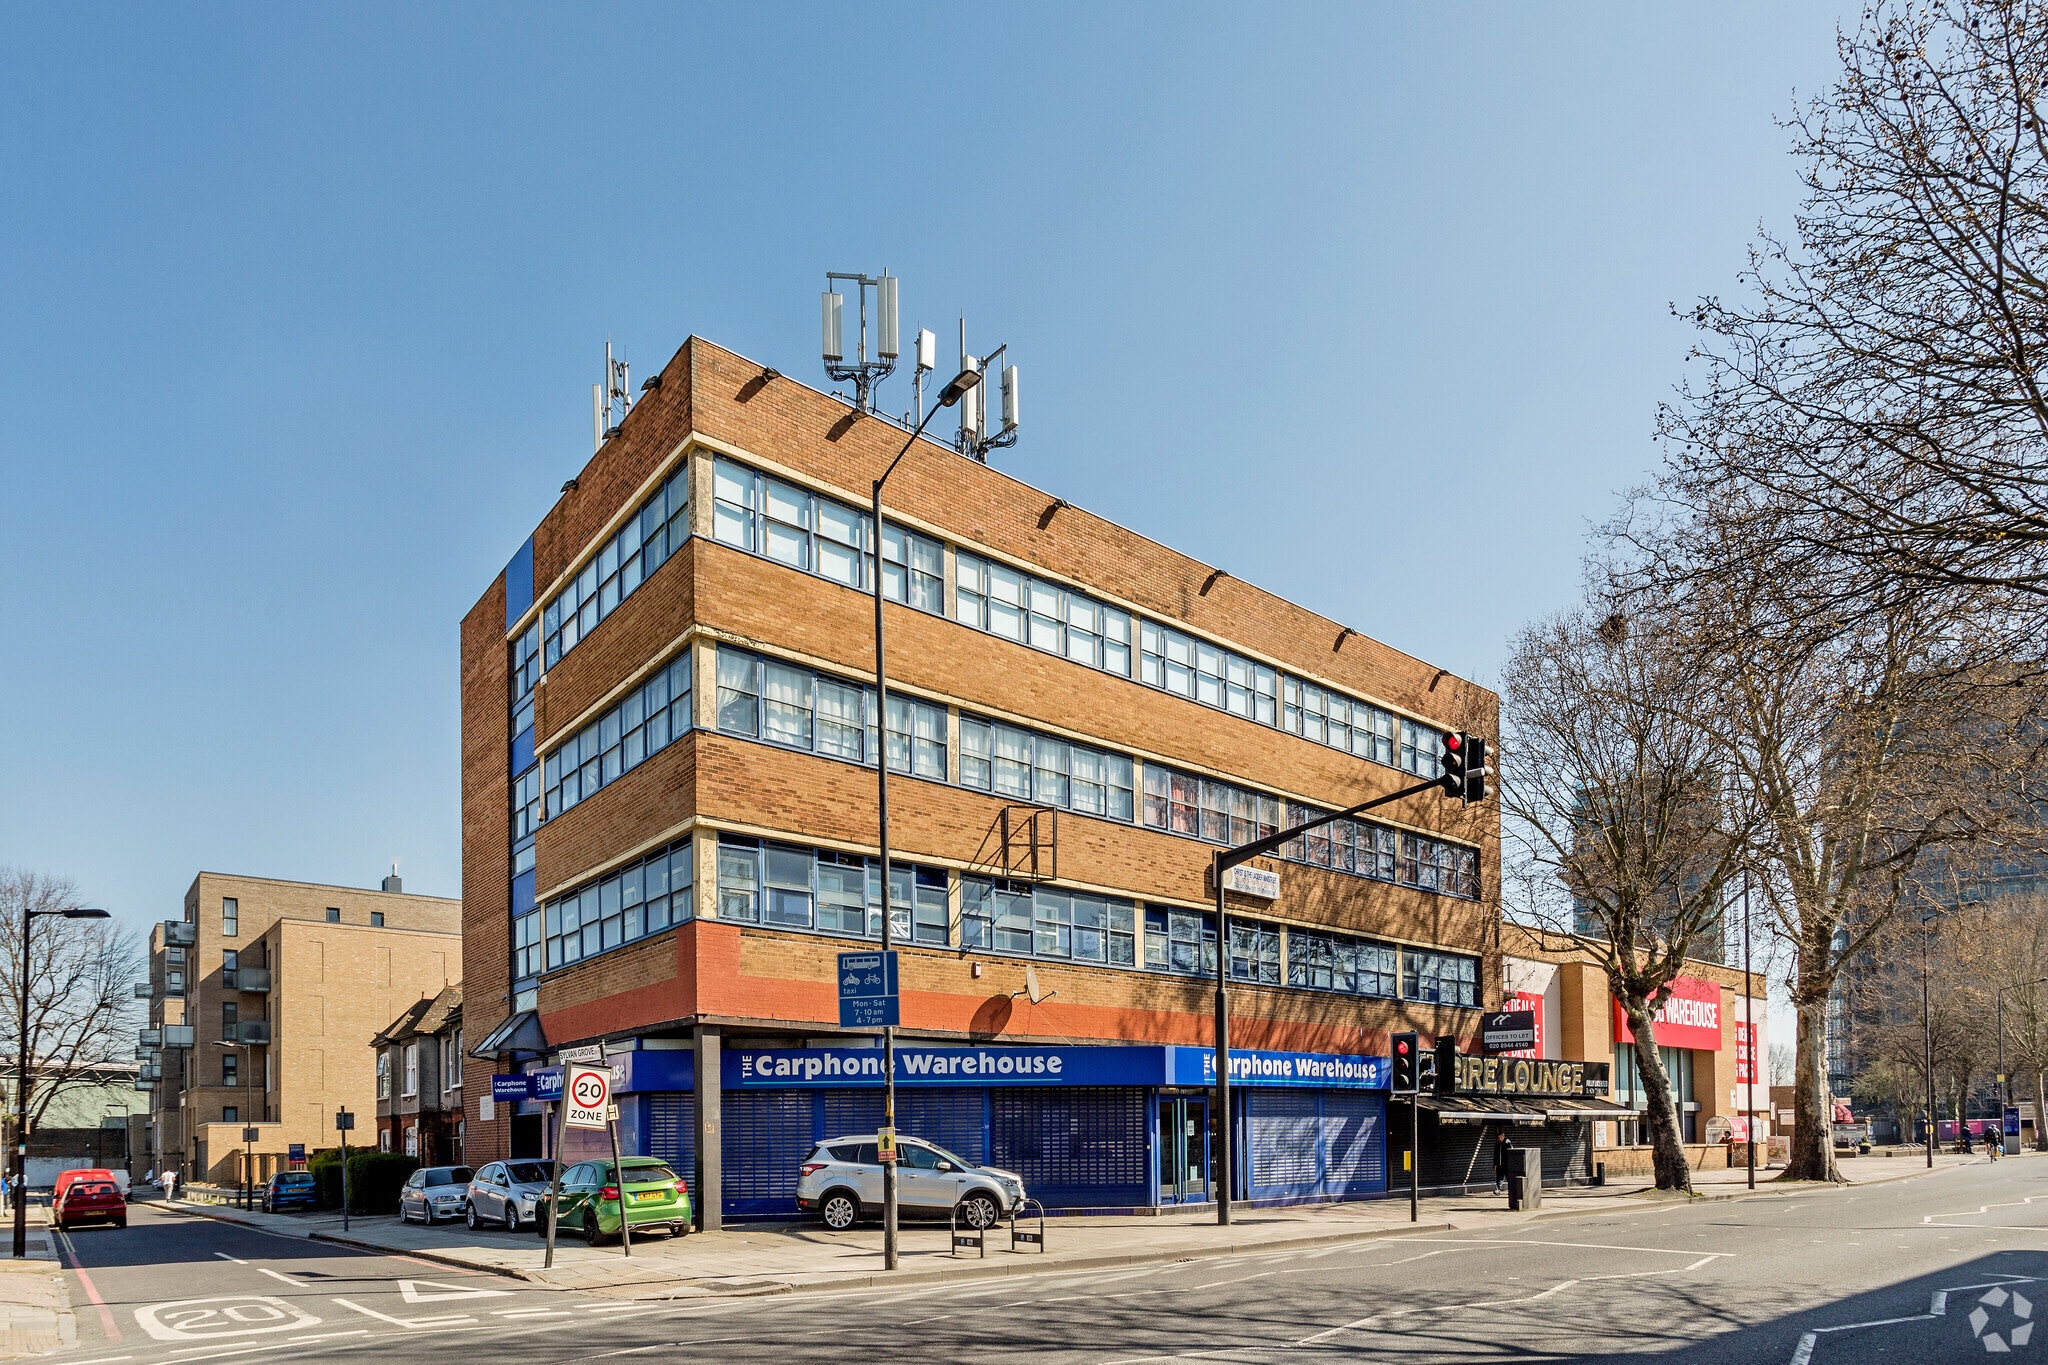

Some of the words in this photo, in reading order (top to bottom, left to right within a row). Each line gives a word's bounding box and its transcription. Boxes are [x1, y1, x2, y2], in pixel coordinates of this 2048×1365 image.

[1665, 997, 1718, 1029] WAREHOUSE
[1737, 1026, 1753, 1043] DEAS
[559, 1049, 578, 1060] SYLVAN
[577, 1047, 595, 1057] GROVE
[742, 1055, 752, 1079] THE
[902, 1052, 1063, 1075] Warehouse
[1203, 1053, 1211, 1076] THE
[1211, 1054, 1292, 1079] rphone
[1295, 1058, 1377, 1079] Warehouse
[1738, 1062, 1755, 1079] PACS
[497, 1080, 527, 1088] Carphone
[540, 1071, 565, 1093] Carph
[1502, 1059, 1584, 1095] LOUNGE
[578, 1082, 602, 1099] 20
[570, 1109, 603, 1121] ZONE
[164, 1304, 287, 1330] 20
